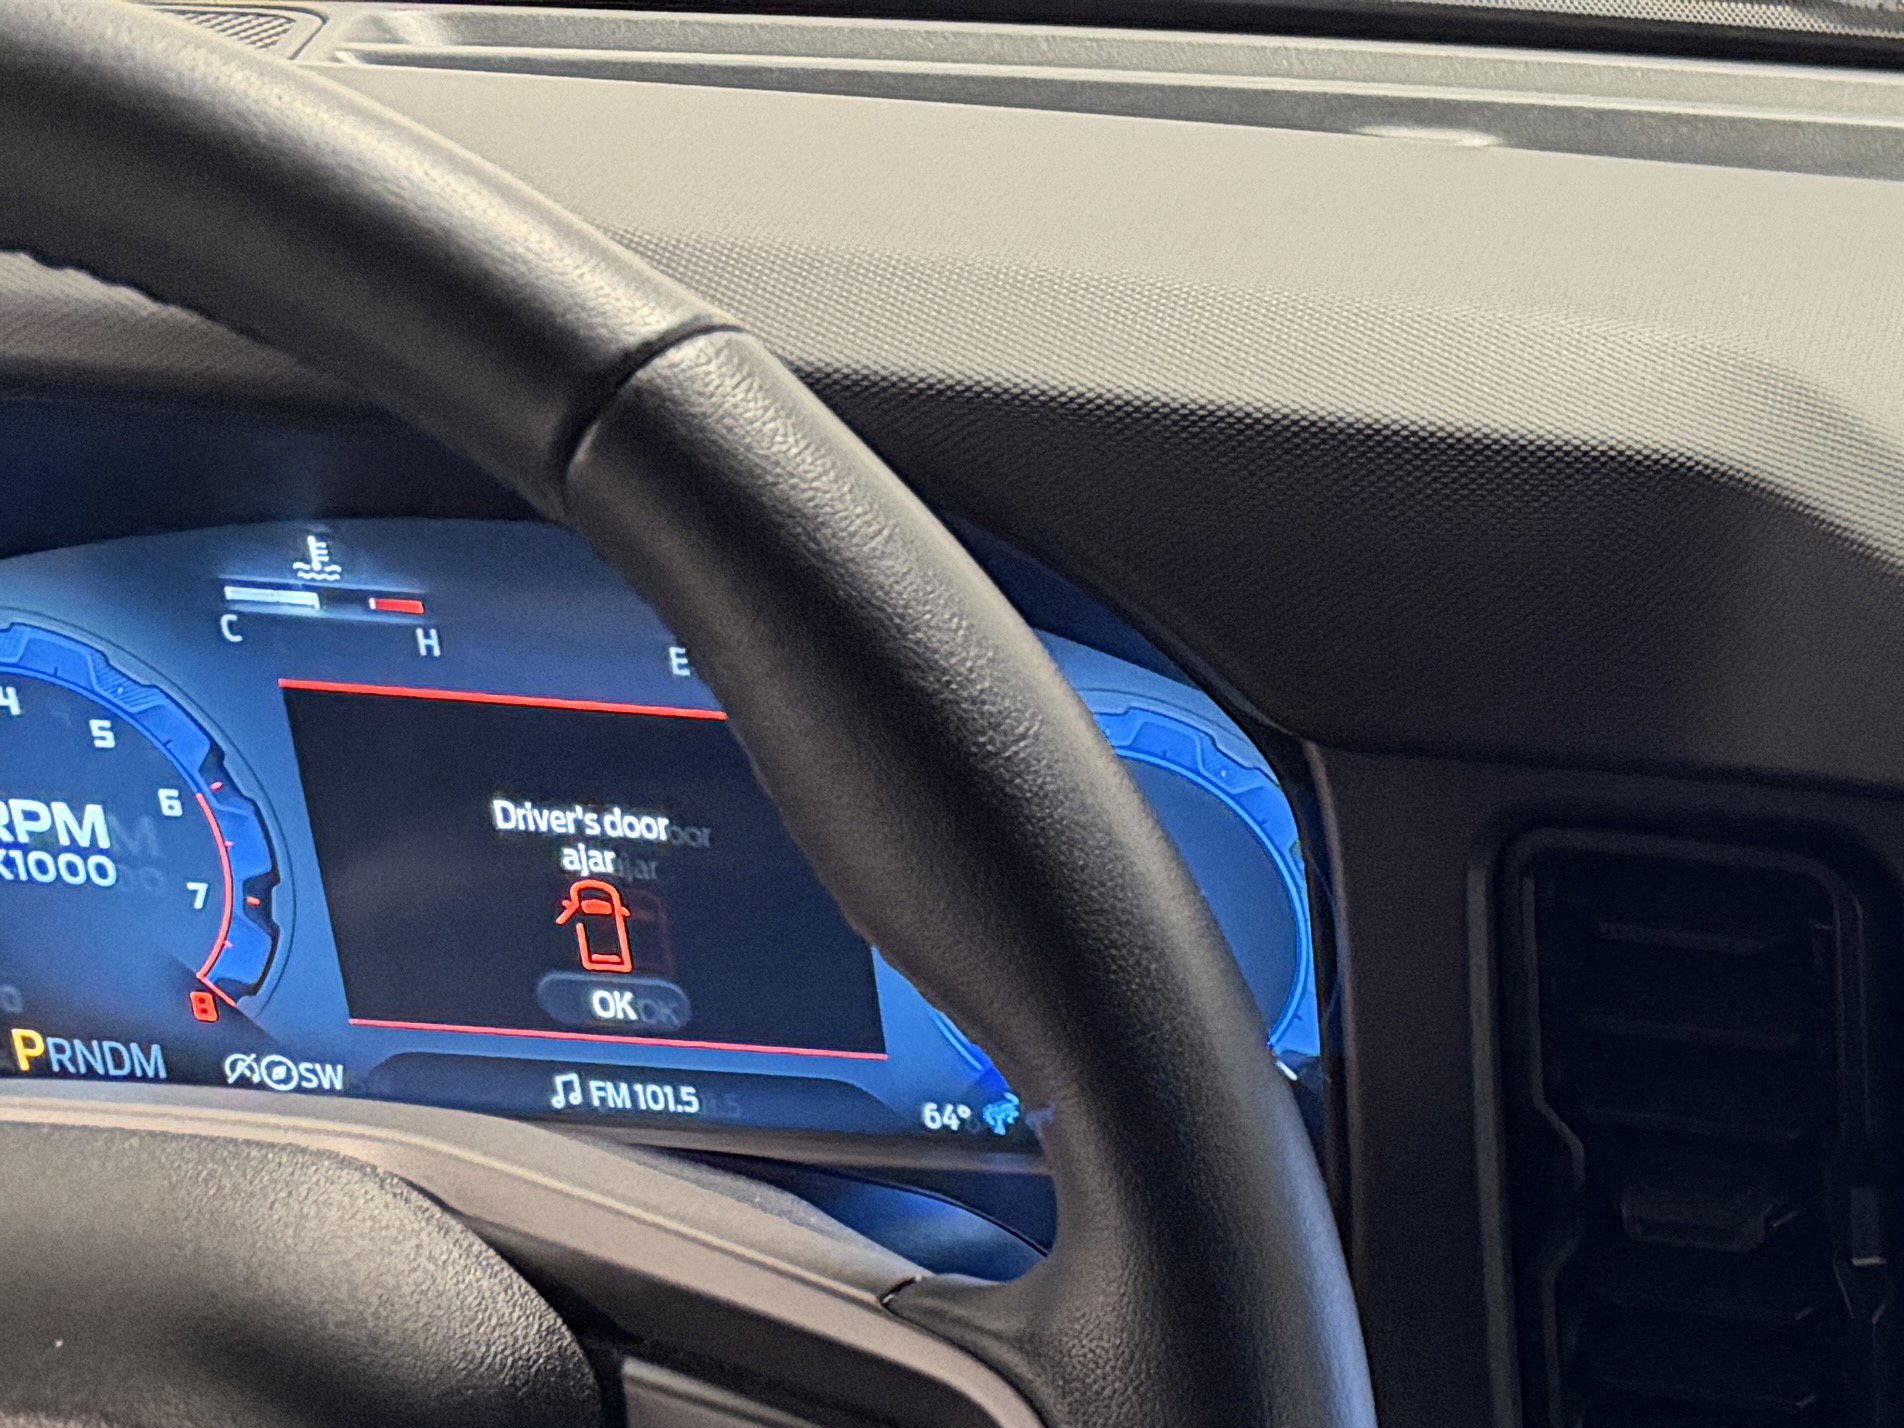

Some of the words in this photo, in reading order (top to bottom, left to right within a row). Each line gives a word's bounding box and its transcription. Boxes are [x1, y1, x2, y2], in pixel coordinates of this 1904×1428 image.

[220, 615, 243, 643] C
[416, 629, 441, 658] H
[669, 648, 691, 676] E
[90, 719, 115, 748] 5
[157, 788, 183, 816] 6
[493, 798, 600, 837] Driver's
[603, 806, 670, 841] door
[562, 844, 618, 877] ajar
[186, 881, 208, 910] 7
[592, 989, 639, 1020] OK
[301, 1061, 344, 1091] SW
[590, 1080, 631, 1110] FM
[634, 1083, 699, 1115] 101.5
